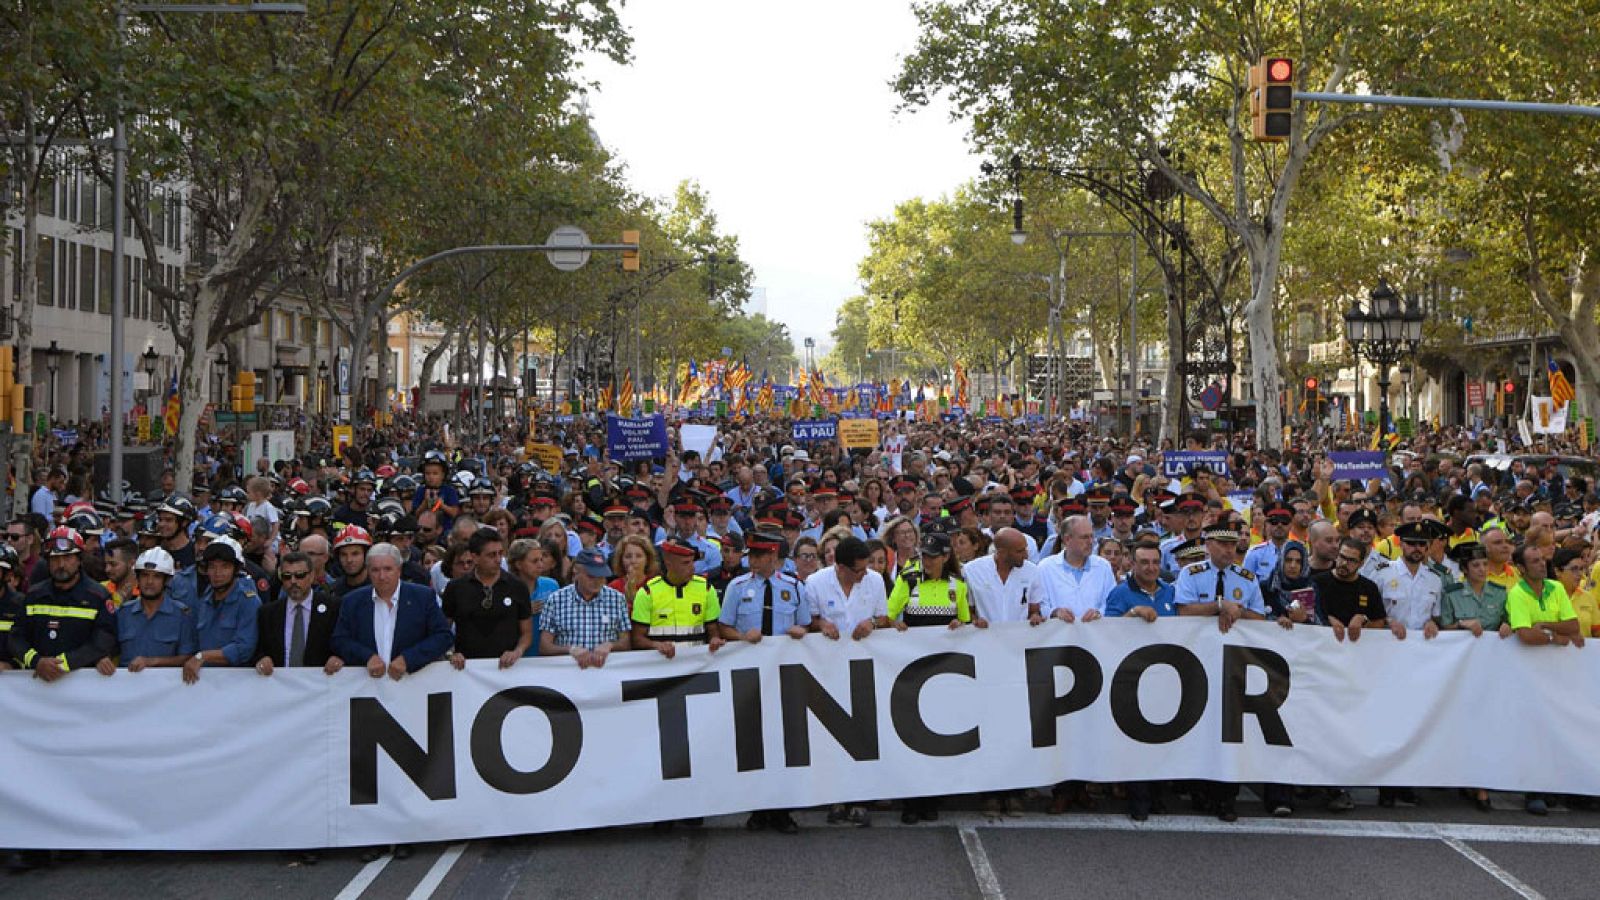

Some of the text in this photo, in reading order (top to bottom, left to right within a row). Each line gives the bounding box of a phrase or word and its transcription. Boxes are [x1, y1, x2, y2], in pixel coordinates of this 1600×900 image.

[341, 364, 348, 389] P
[793, 428, 808, 438] LA
[810, 427, 835, 437] PAU
[1165, 462, 1187, 475] LA
[349, 643, 1294, 806] NO TINC POR
